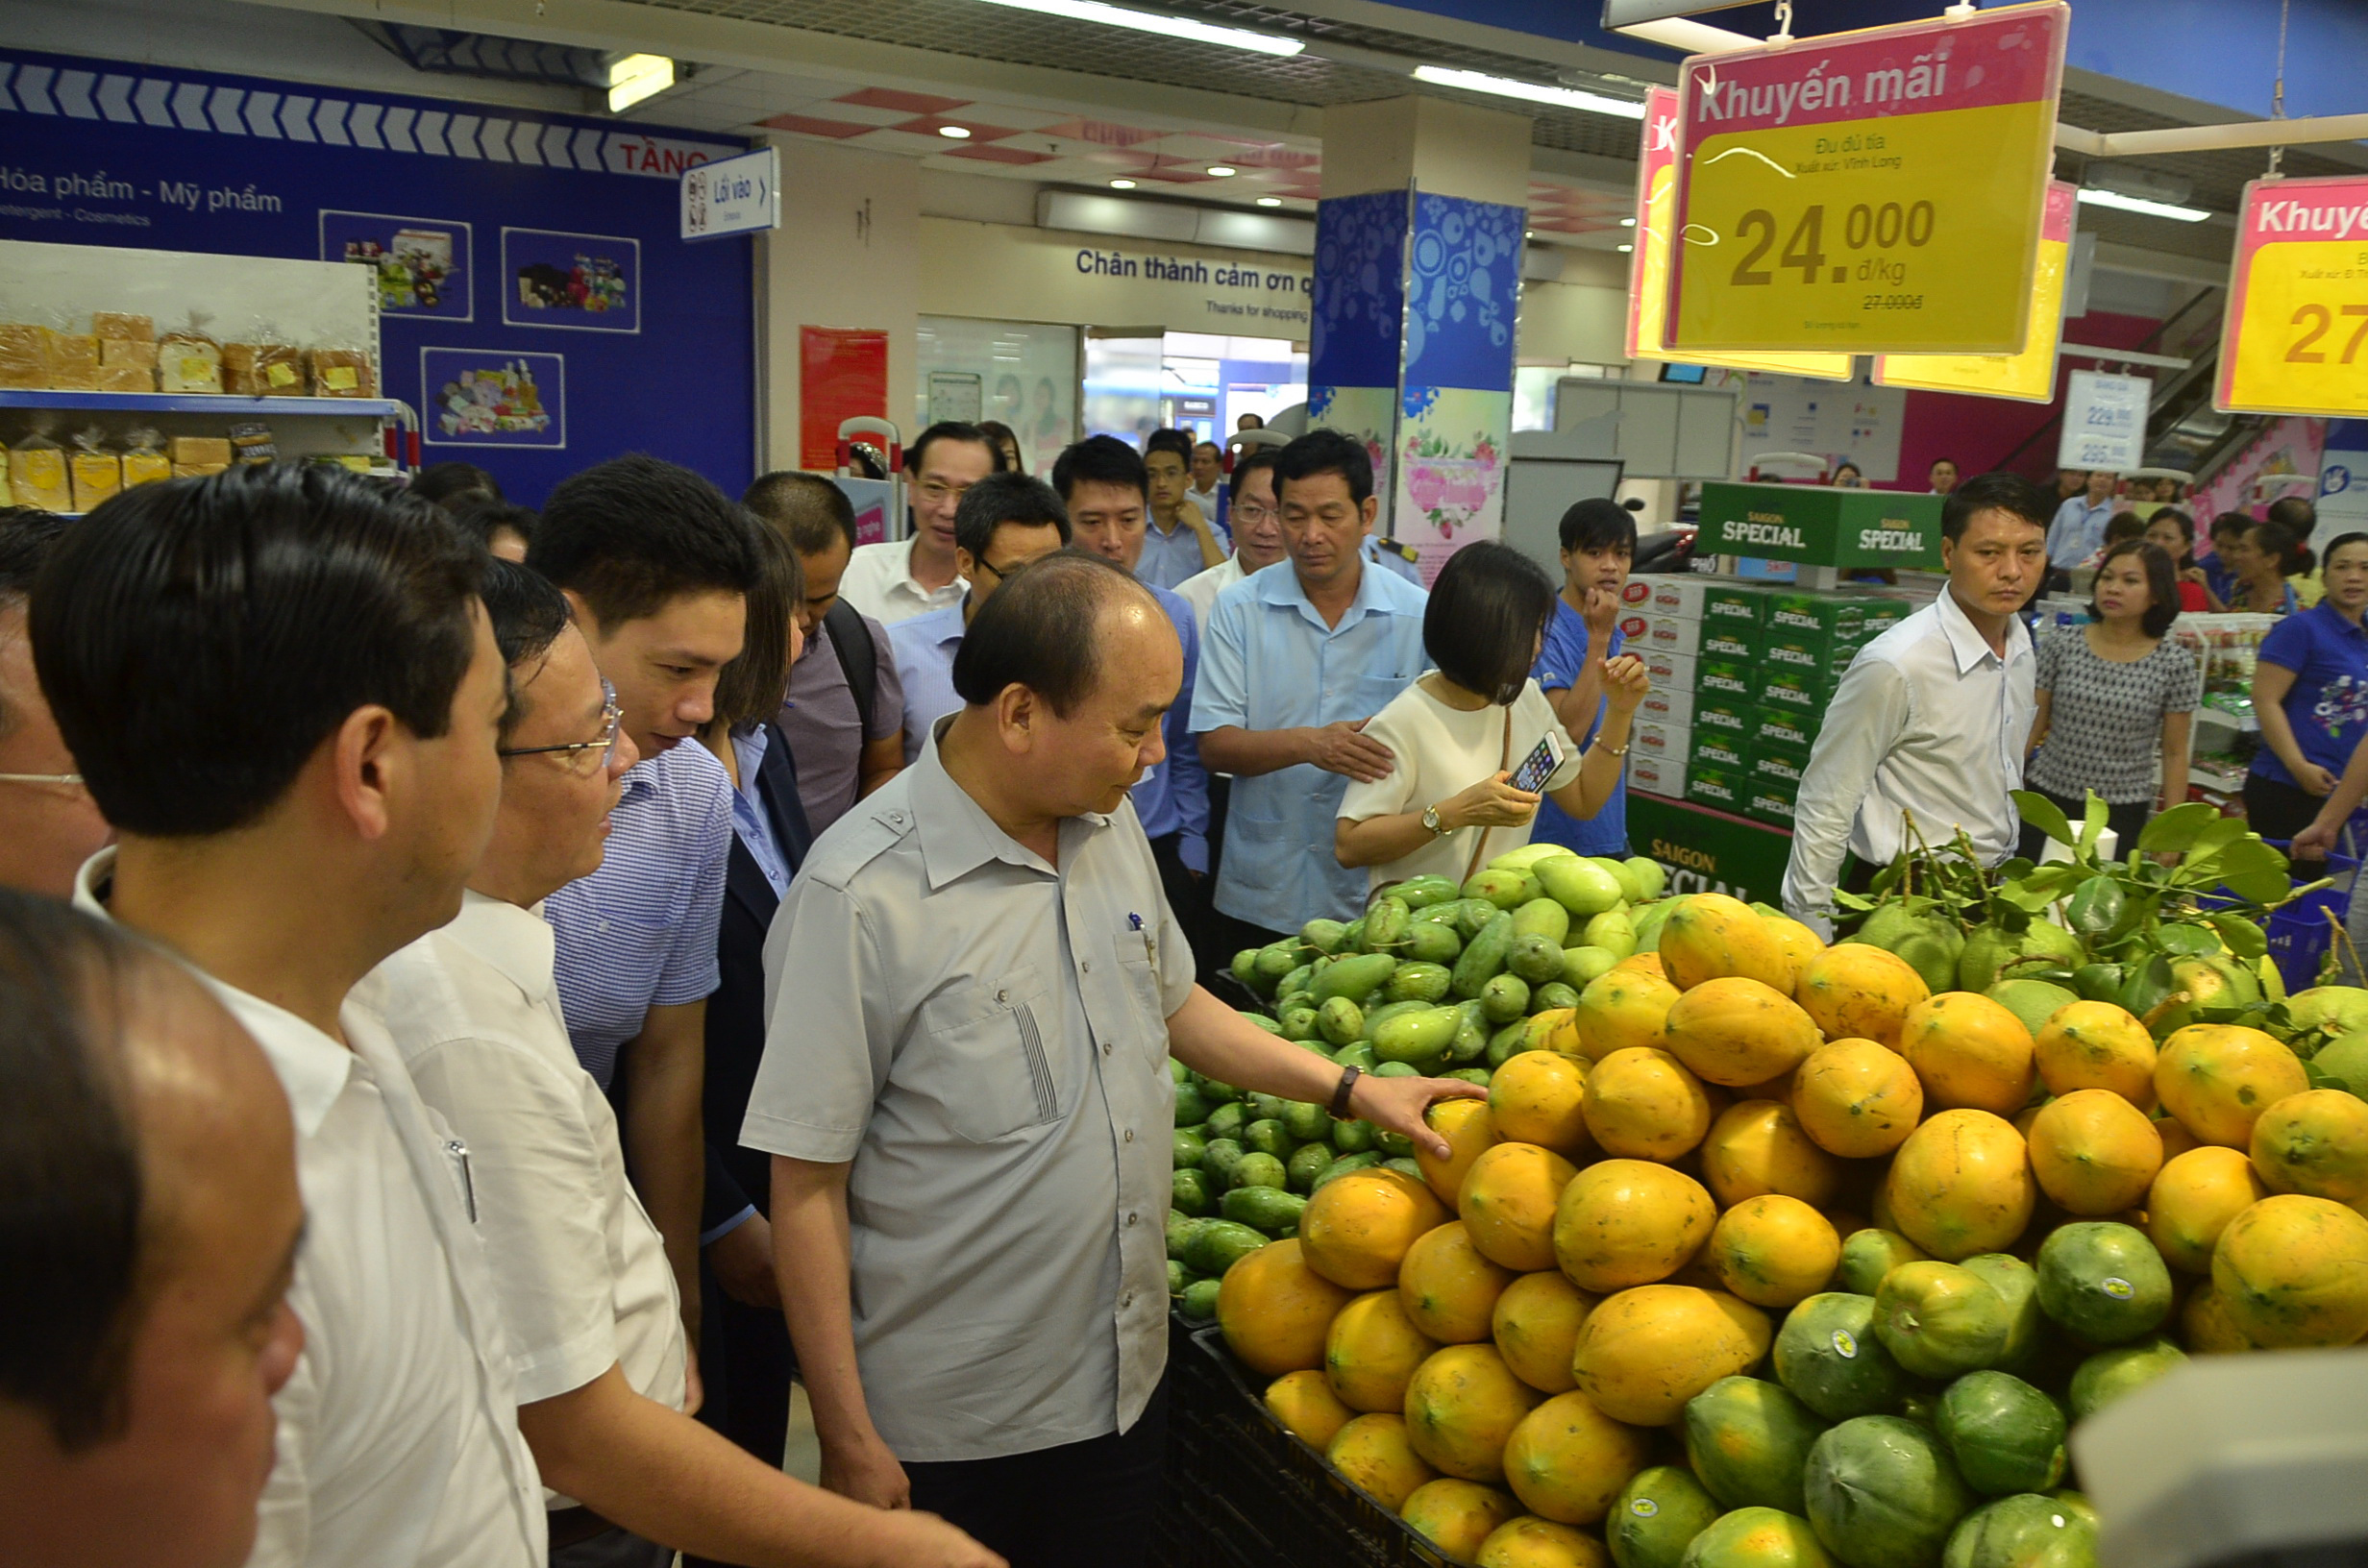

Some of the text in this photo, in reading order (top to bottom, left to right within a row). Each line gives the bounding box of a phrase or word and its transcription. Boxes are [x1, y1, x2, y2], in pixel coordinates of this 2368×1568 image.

[1697, 54, 1948, 124] Khuyến mãi
[55, 169, 134, 201] phẩm
[160, 180, 200, 211] Mỹ
[208, 184, 282, 213] phẩm
[74, 208, 151, 227] Cosmetics
[1076, 250, 1138, 279] Chân
[1145, 257, 1208, 285] thành
[1215, 261, 1259, 288] cảm
[1267, 273, 1295, 291] ơn
[1857, 257, 1907, 286] đ/kg
[1206, 299, 1308, 323] Thanks for shopping
[1721, 521, 1807, 549] SPECIAL
[1859, 529, 1925, 551] SPECIAL
[1711, 602, 1754, 619] SPECIAL
[1774, 611, 1821, 629] SPECIAL
[1706, 639, 1750, 656] SPECIAL
[1769, 648, 1816, 666] SPECIAL
[1703, 675, 1747, 693] SPECIAL
[1765, 685, 1813, 705] SPECIAL
[1699, 711, 1743, 728] SPECIAL
[1761, 723, 1807, 744] SPECIAL
[1697, 746, 1741, 765] SPECIAL
[1757, 760, 1801, 780] SPECIAL
[1691, 780, 1735, 800] SPECIAL
[1652, 839, 1716, 873] SAIGON
